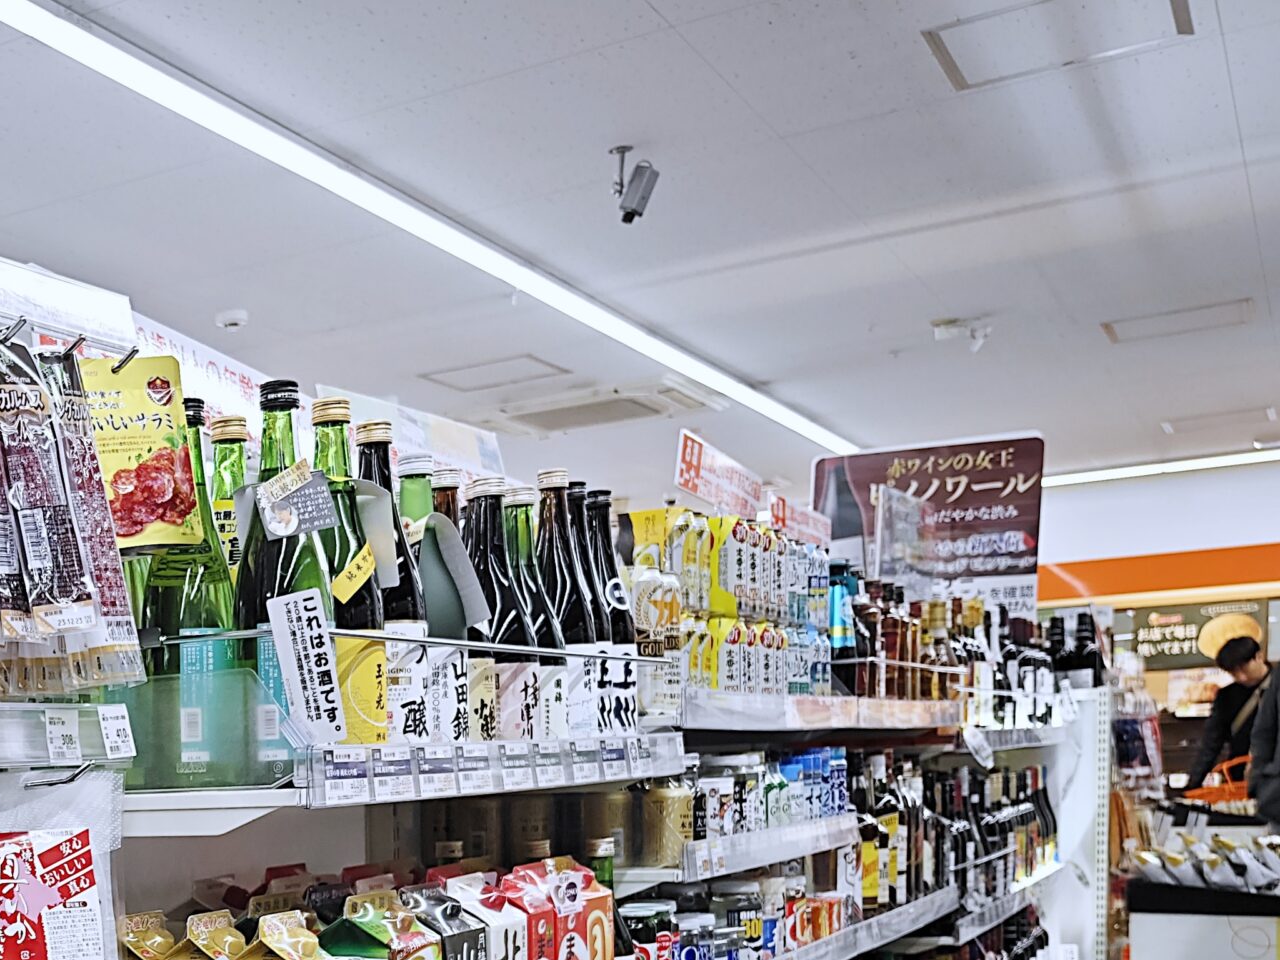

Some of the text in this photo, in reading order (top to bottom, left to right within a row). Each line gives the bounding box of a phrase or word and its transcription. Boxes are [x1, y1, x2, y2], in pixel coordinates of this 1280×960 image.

[886, 447, 1016, 480] 赤ワインの女王
[302, 596, 342, 733] これはお酒です。
[59, 837, 82, 857] 安心
[43, 856, 87, 886] おいしい
[66, 875, 90, 896] 真心
